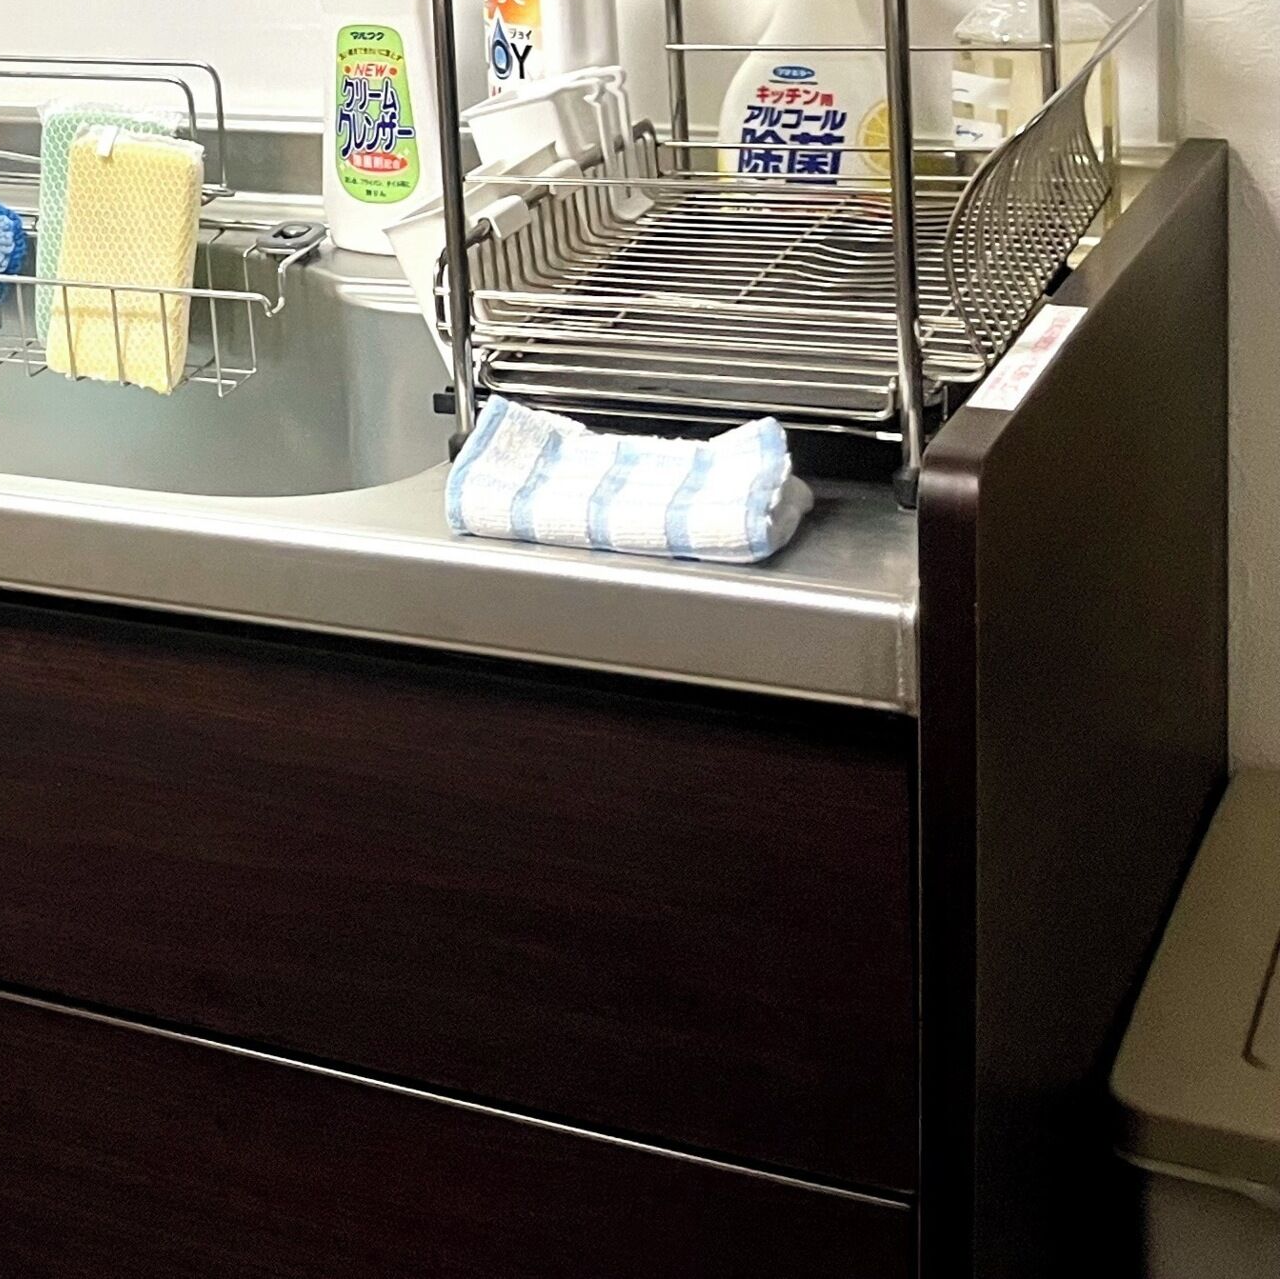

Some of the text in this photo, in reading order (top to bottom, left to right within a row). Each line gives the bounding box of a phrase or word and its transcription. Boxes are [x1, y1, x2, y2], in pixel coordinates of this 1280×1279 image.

[509, 28, 532, 40] ジョイ
[354, 63, 388, 77] NEW
[343, 78, 398, 111] クリーム
[743, 105, 847, 131] アルコール
[338, 111, 415, 157] クレンザー
[737, 128, 845, 185] 除菌
